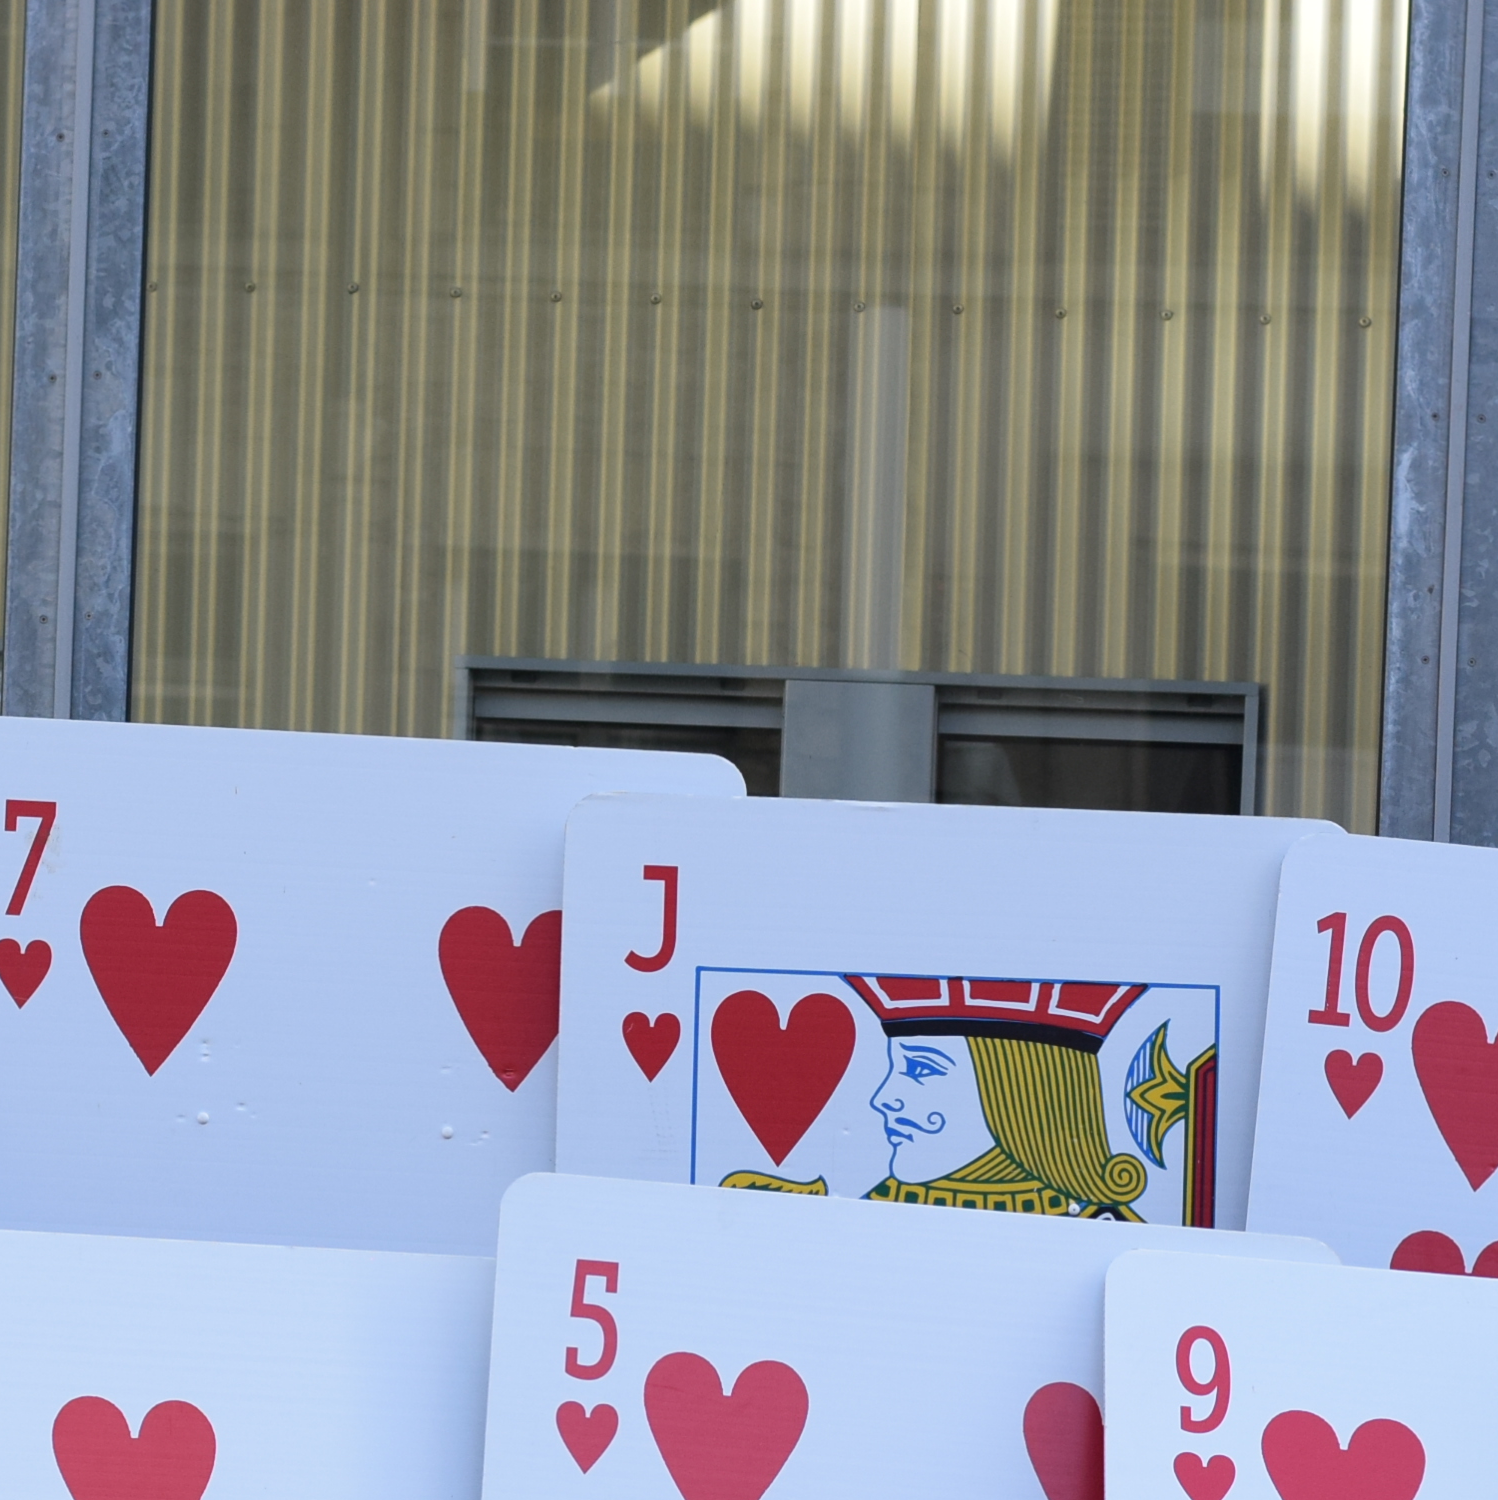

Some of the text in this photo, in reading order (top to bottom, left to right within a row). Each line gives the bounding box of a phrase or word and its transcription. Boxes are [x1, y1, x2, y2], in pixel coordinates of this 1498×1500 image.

[5, 799, 58, 916] 7
[624, 865, 680, 973] J
[1307, 911, 1416, 1033] 10
[565, 1259, 620, 1381] 5
[1175, 1325, 1233, 1434] 9
